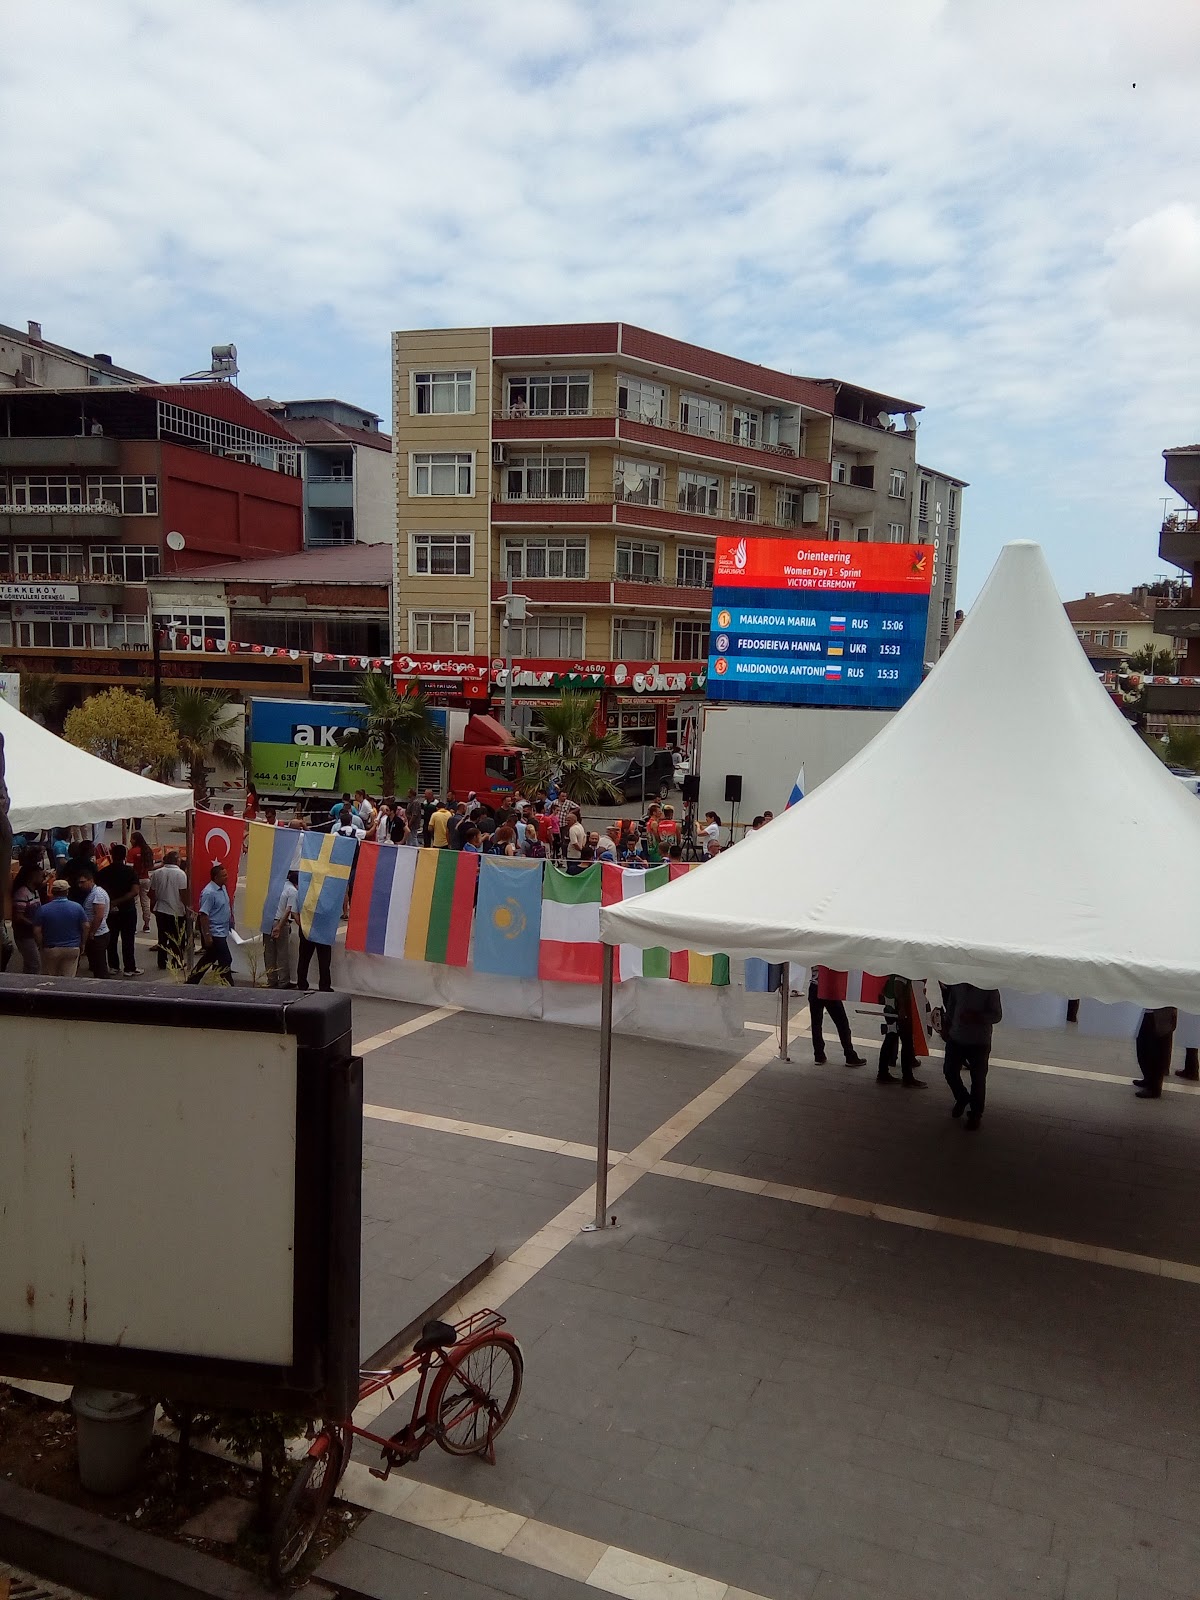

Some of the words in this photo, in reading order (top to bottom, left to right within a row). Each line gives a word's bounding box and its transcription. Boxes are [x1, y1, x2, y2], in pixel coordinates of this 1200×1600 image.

[797, 550, 851, 565] Orienteering
[783, 566, 812, 576] Women
[813, 568, 828, 579] Day
[840, 569, 862, 579] Sprint
[787, 578, 817, 588] VICTORY
[818, 579, 857, 589] CEREMONY
[739, 615, 786, 626] MAKAROVA
[787, 617, 817, 627] MARIIA
[851, 619, 869, 630] RUS
[881, 620, 904, 631] 15:06
[737, 639, 790, 651] FEDOSIEIEVA
[791, 641, 822, 652] HANNA
[849, 643, 867, 654] UKR
[879, 645, 901, 656] 15:31
[137, 662, 204, 679] MRKET
[585, 664, 606, 674] 4600
[736, 663, 789, 675] NAIDIONOVA
[847, 668, 864, 679] RUS
[877, 669, 899, 680] 15:33
[285, 760, 335, 768] JENERATÖR
[363, 765, 384, 774] ALA
[254, 772, 271, 780] 444
[281, 774, 297, 782] 630
